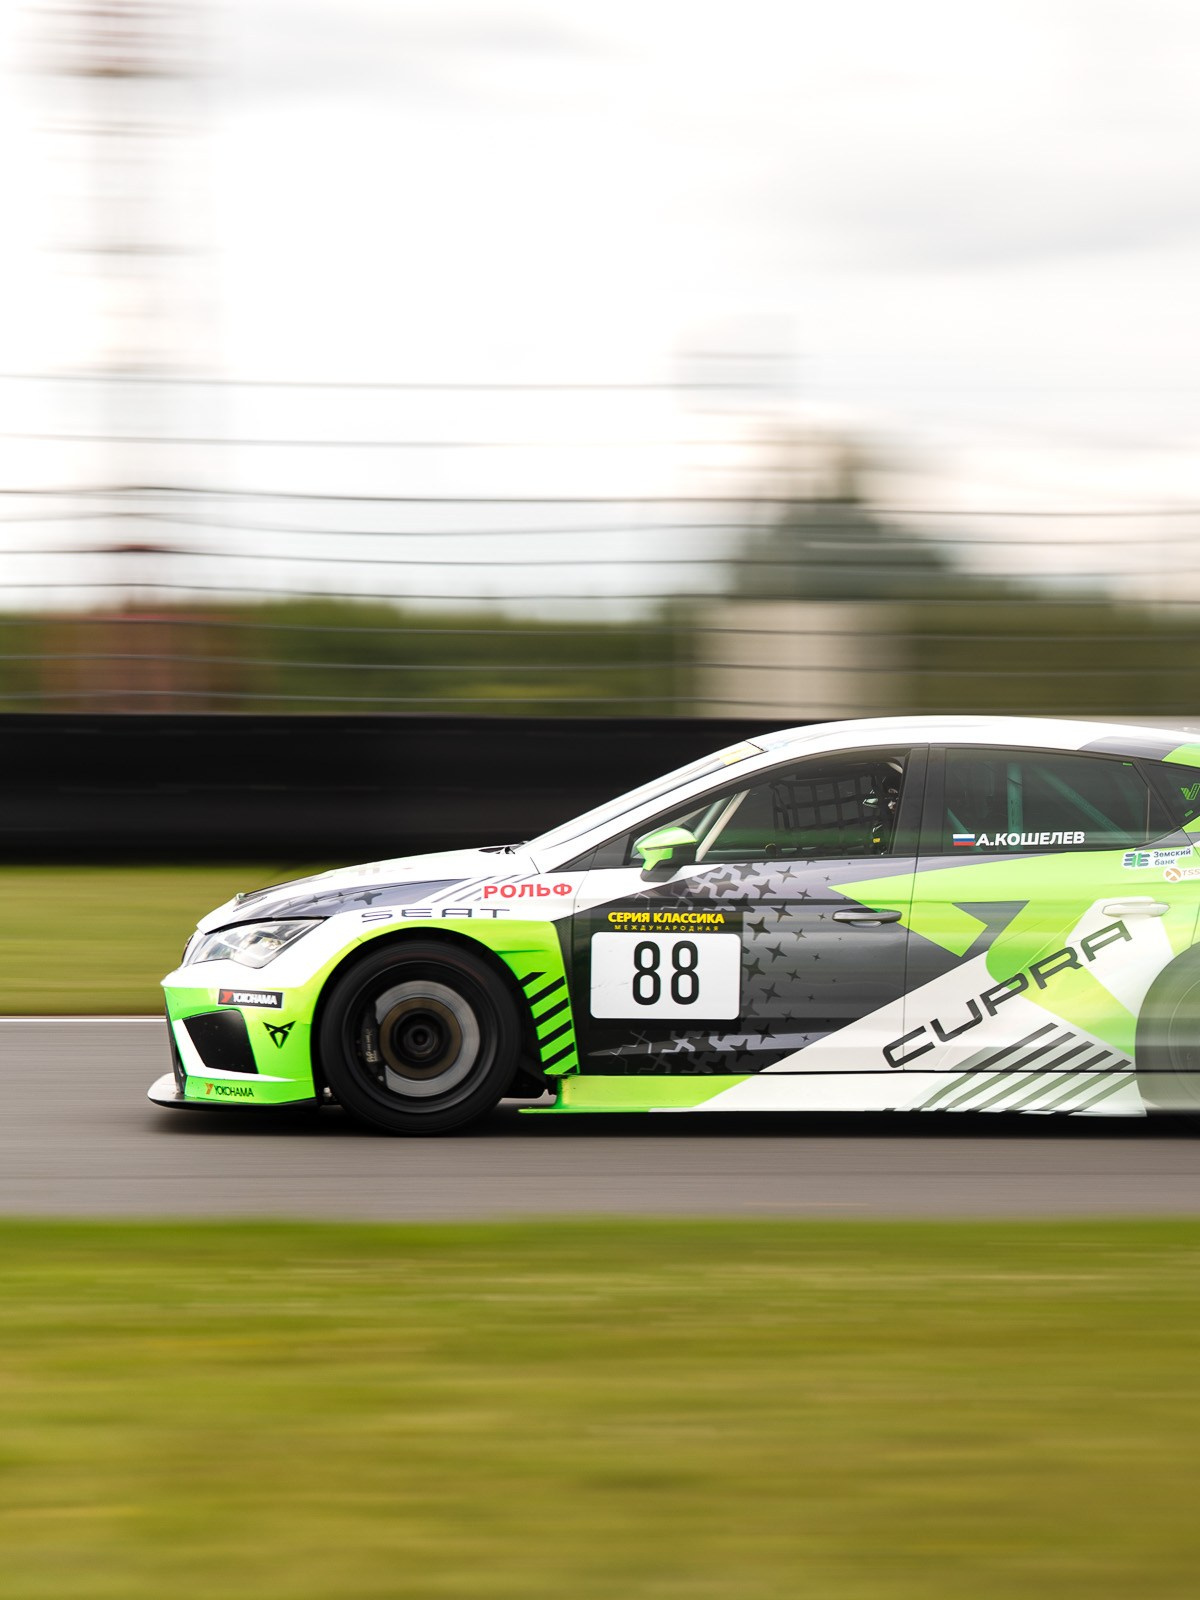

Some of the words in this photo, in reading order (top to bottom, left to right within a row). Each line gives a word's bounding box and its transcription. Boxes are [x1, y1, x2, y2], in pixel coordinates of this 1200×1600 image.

[975, 831, 1085, 846] А.КОШЕЛЕВ
[1153, 848, 1191, 858] Земский
[483, 883, 572, 899] РОЛЬФ
[361, 908, 510, 923] SEAT
[607, 911, 650, 923] СЕРИЯ
[653, 912, 725, 924] КЛАССИКА
[614, 924, 719, 932] МЕЖДУНАРОДНАЯ
[632, 940, 700, 1006] 88
[231, 992, 278, 1006] YOKOHAMA
[882, 920, 1132, 1069] CUPRA
[214, 1084, 255, 1098] YOKOHAMA
